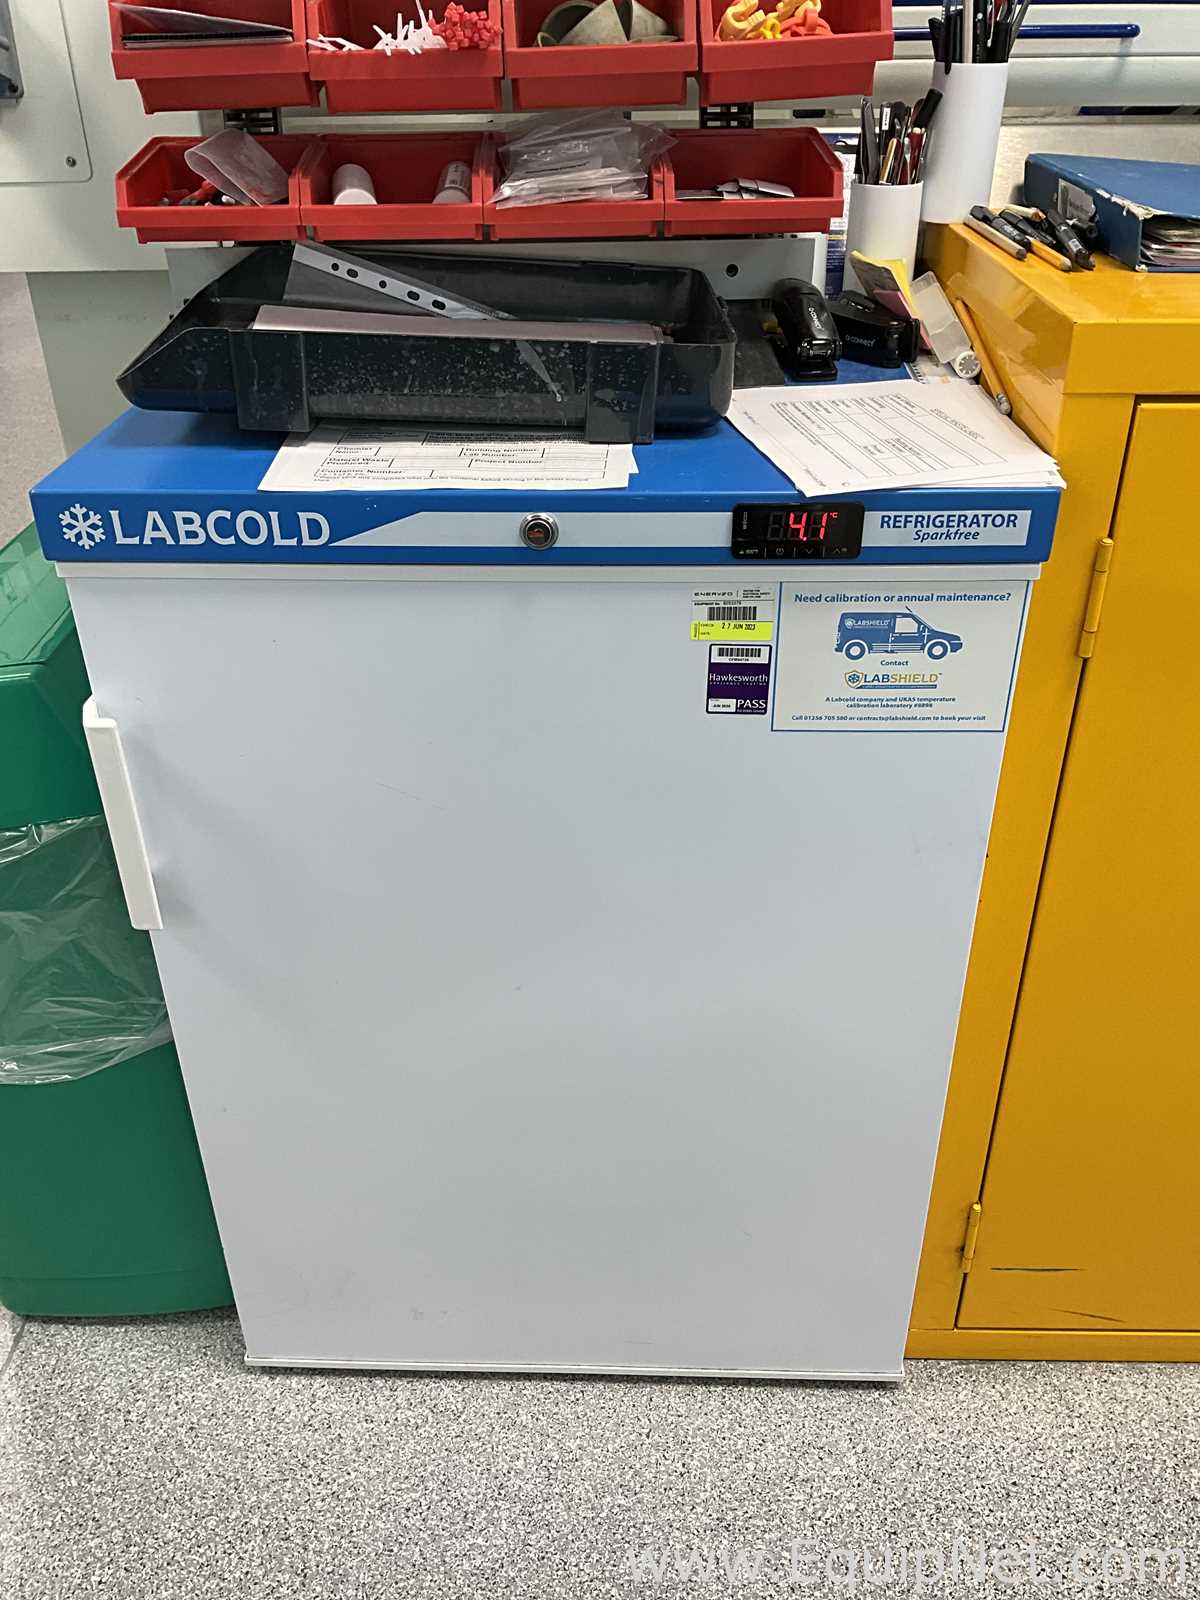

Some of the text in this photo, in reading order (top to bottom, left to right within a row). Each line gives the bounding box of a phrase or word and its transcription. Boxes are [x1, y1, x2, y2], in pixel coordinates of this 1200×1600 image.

[880, 513, 1018, 529] REFRIGERATOR
[109, 509, 331, 546] LABCOLD
[913, 529, 980, 543] Sparkfree
[795, 593, 822, 603] Need
[824, 593, 881, 603] calibration
[897, 593, 935, 602] annual
[936, 592, 1012, 602] maintenance?
[744, 623, 756, 631] 2023
[880, 659, 909, 667] Contact
[709, 672, 768, 682] Hawkesworth
[737, 699, 766, 709] PASS
